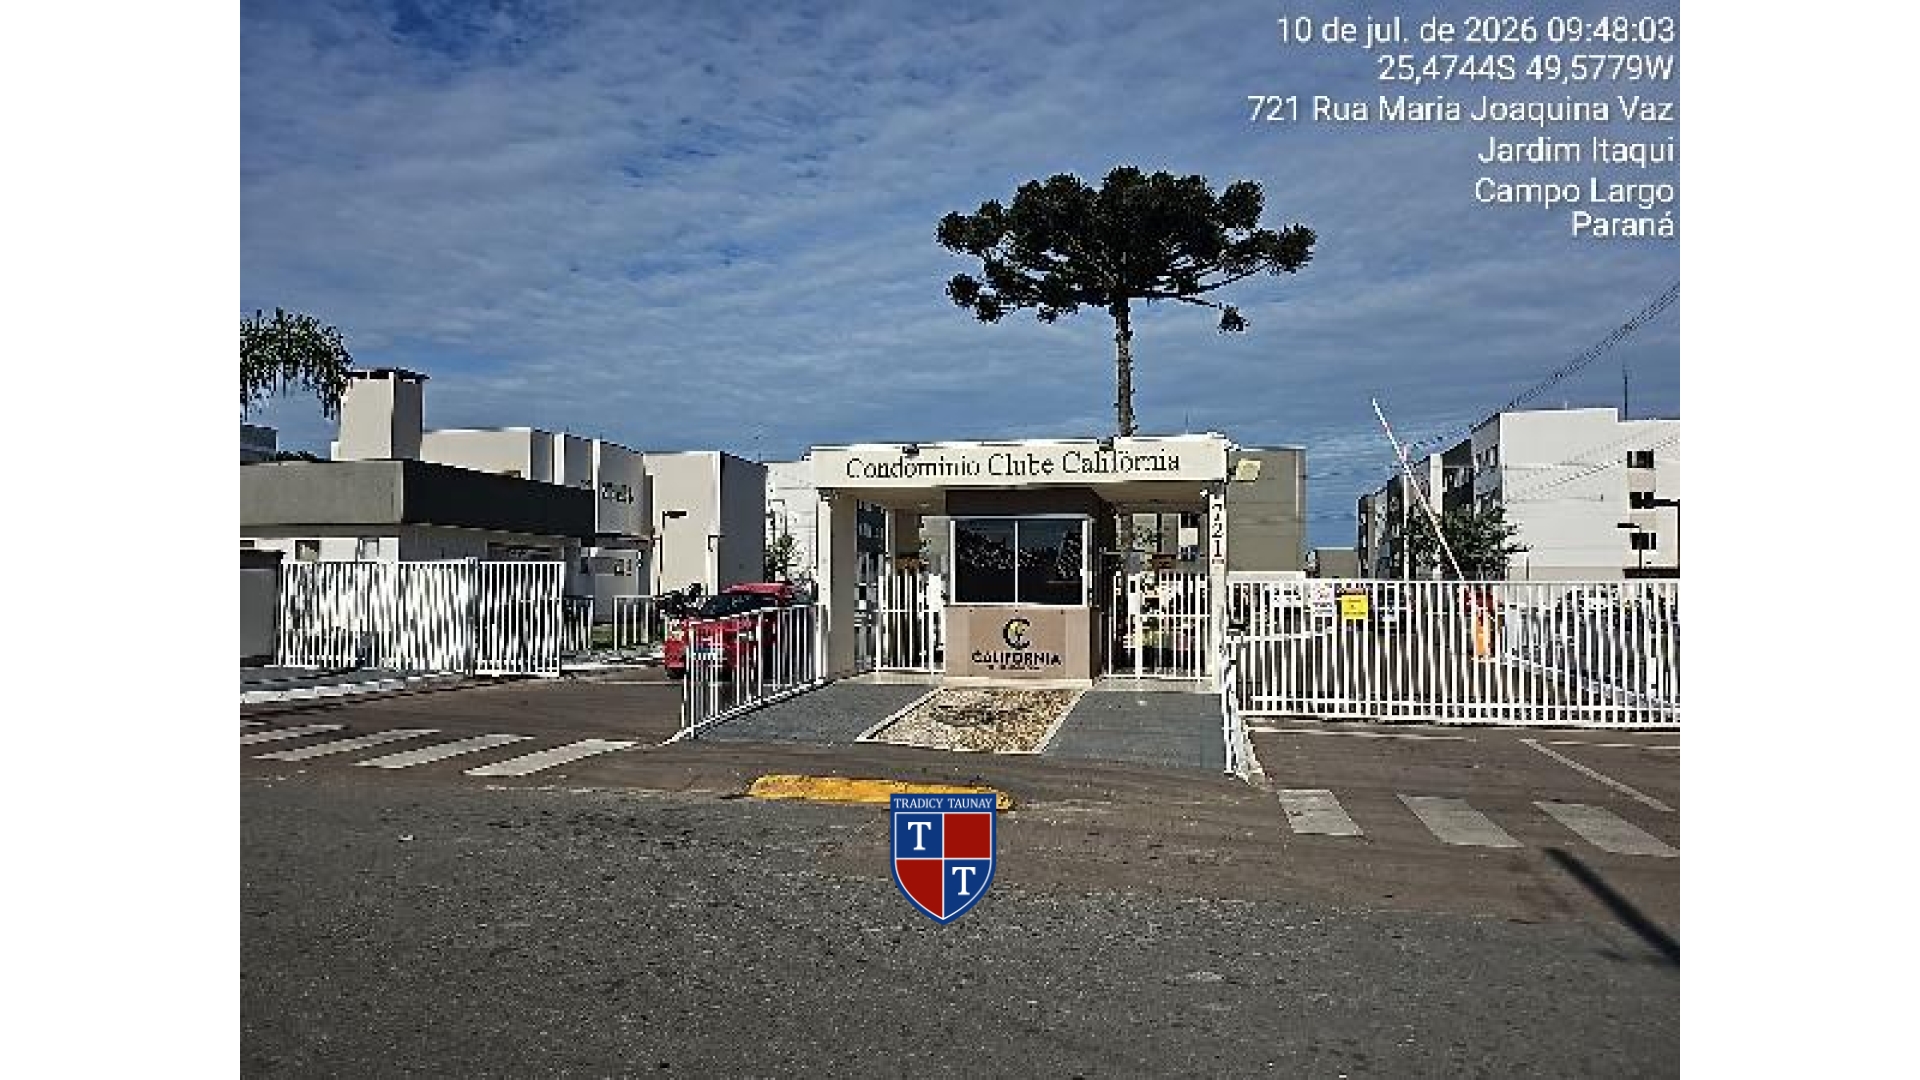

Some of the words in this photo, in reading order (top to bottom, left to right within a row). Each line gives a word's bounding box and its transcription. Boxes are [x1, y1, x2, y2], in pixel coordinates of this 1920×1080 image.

[988, 453, 1054, 476] Clube
[1211, 503, 1223, 558] 721
[971, 651, 1062, 665] CALIFORNIA
